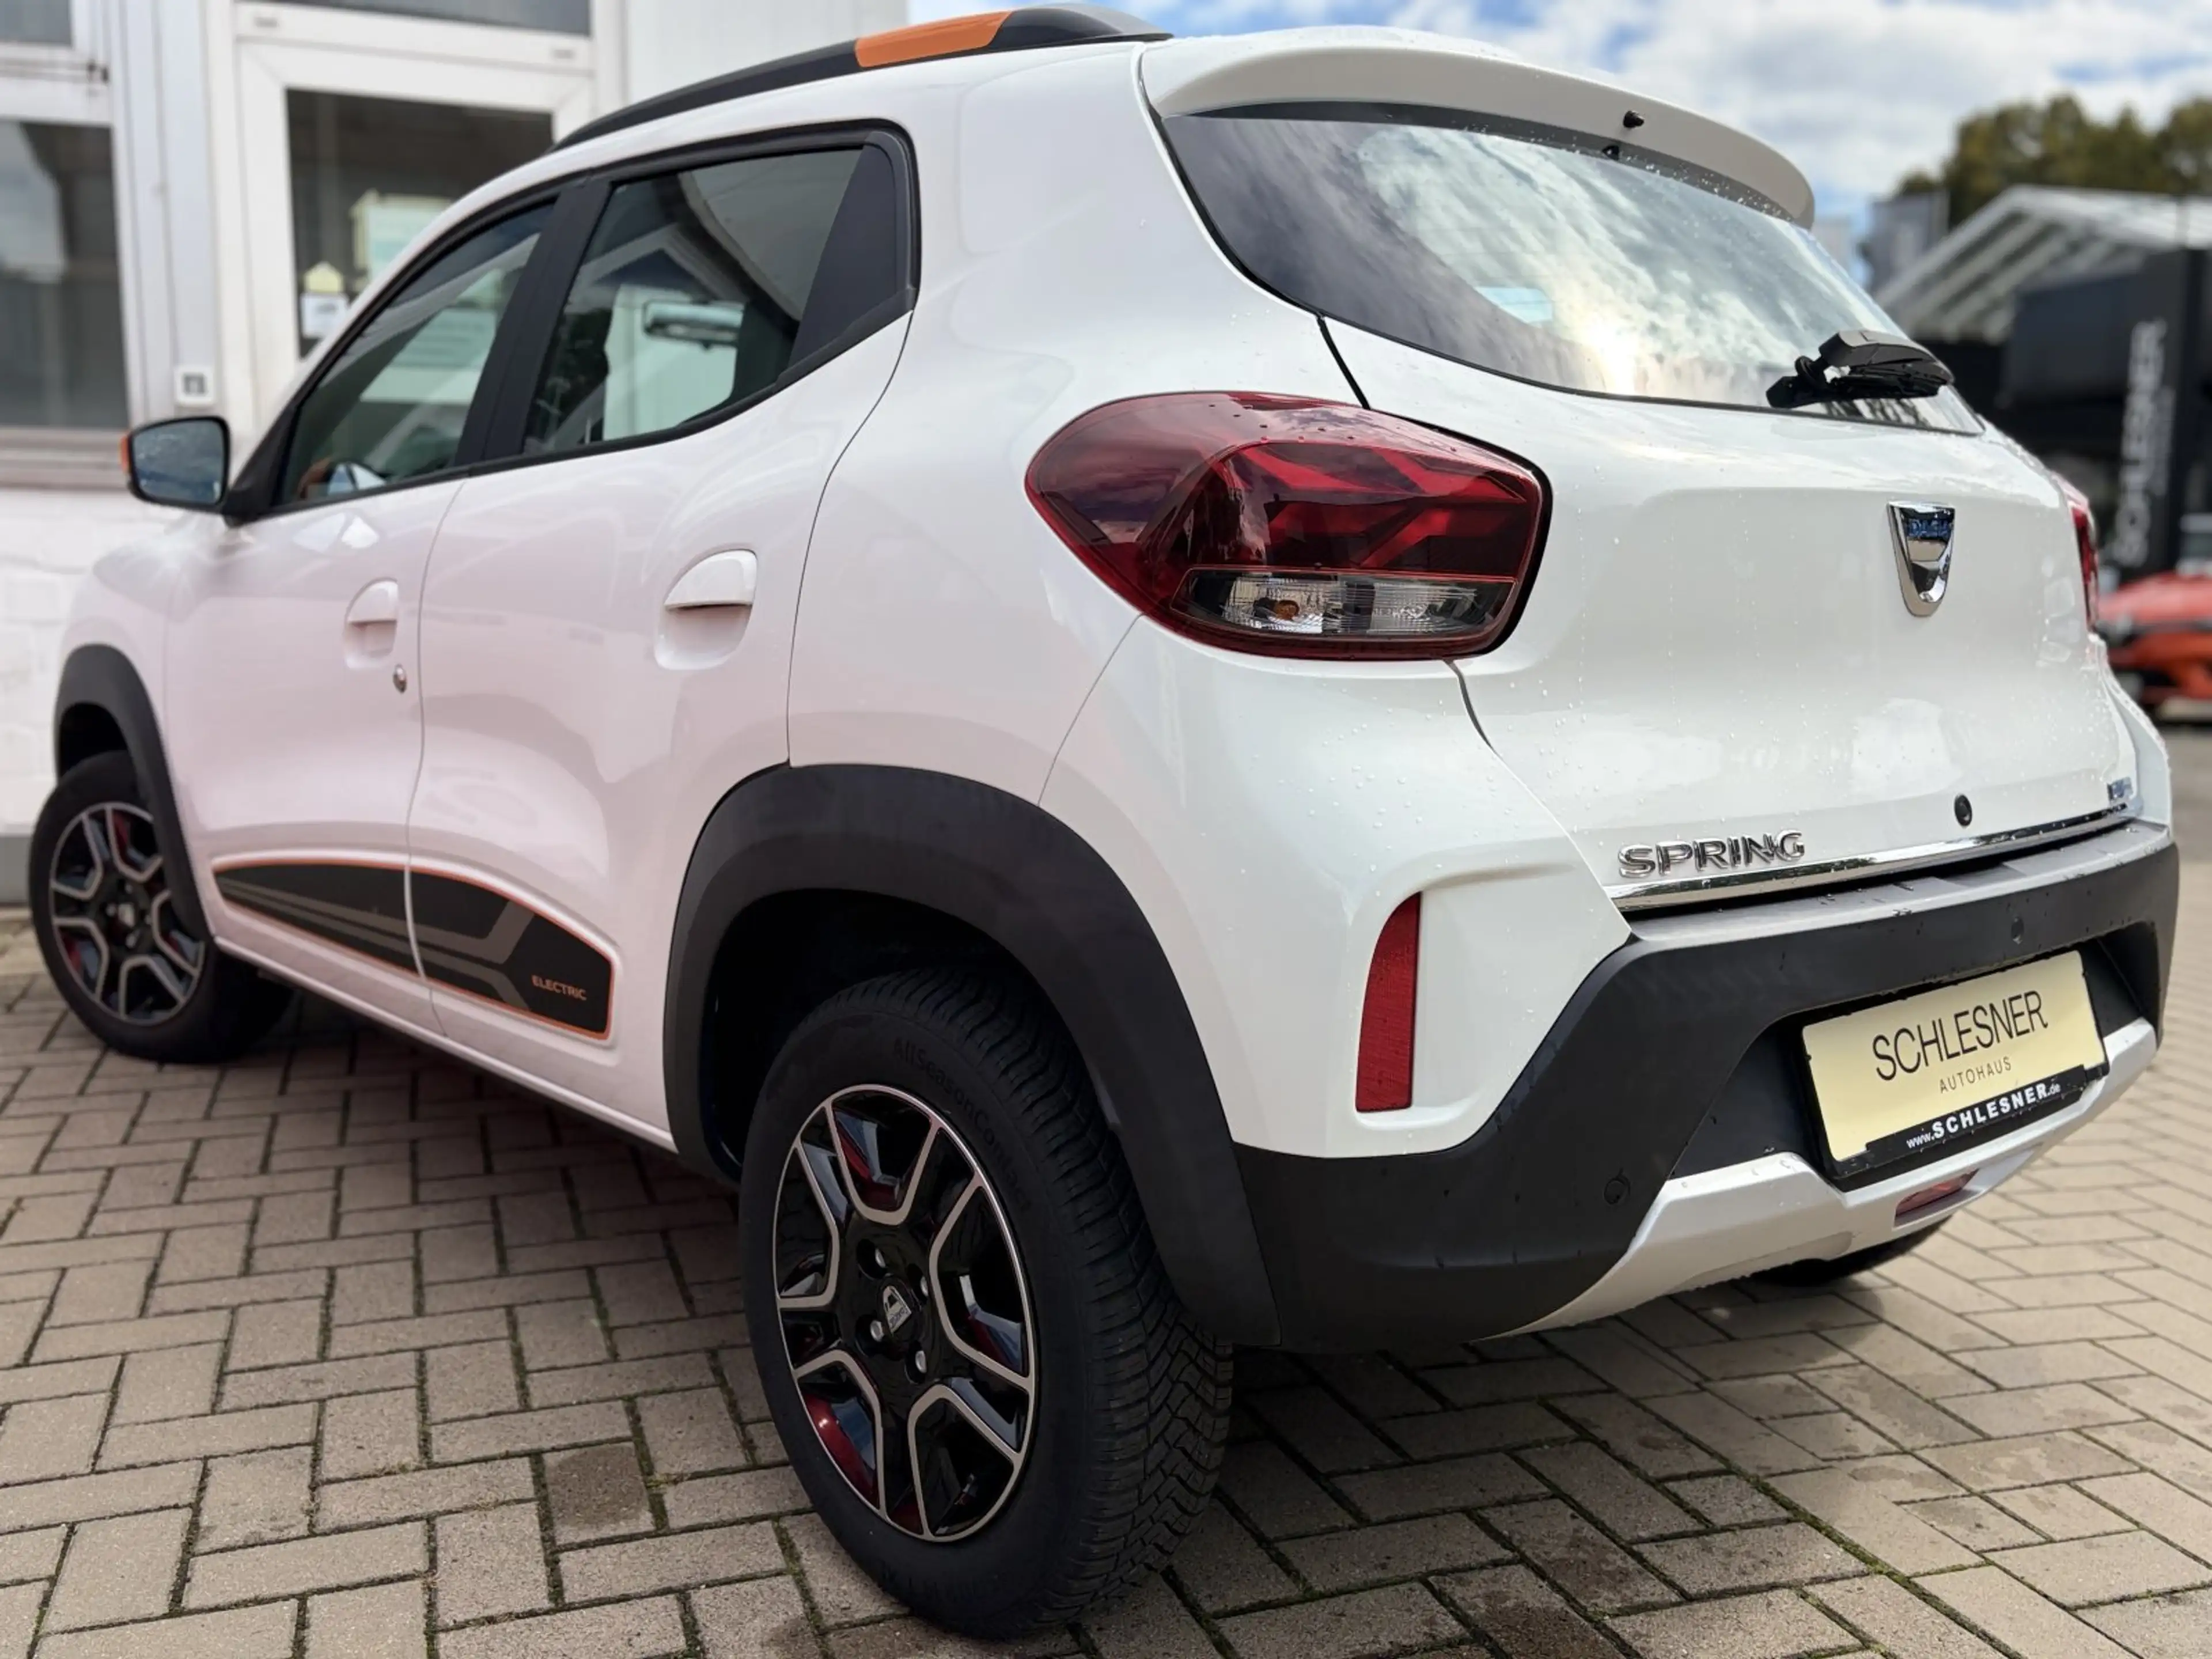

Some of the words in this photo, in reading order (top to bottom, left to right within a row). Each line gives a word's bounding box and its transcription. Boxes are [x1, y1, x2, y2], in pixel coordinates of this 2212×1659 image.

[1618, 829, 1805, 878] SPRING
[532, 974, 588, 1001] ELECTRIC
[1872, 990, 2049, 1081] SCHLESNER
[1939, 1056, 2012, 1094] AUTOHAUS
[1906, 1081, 2061, 1149] www.SCHLESNER.de
